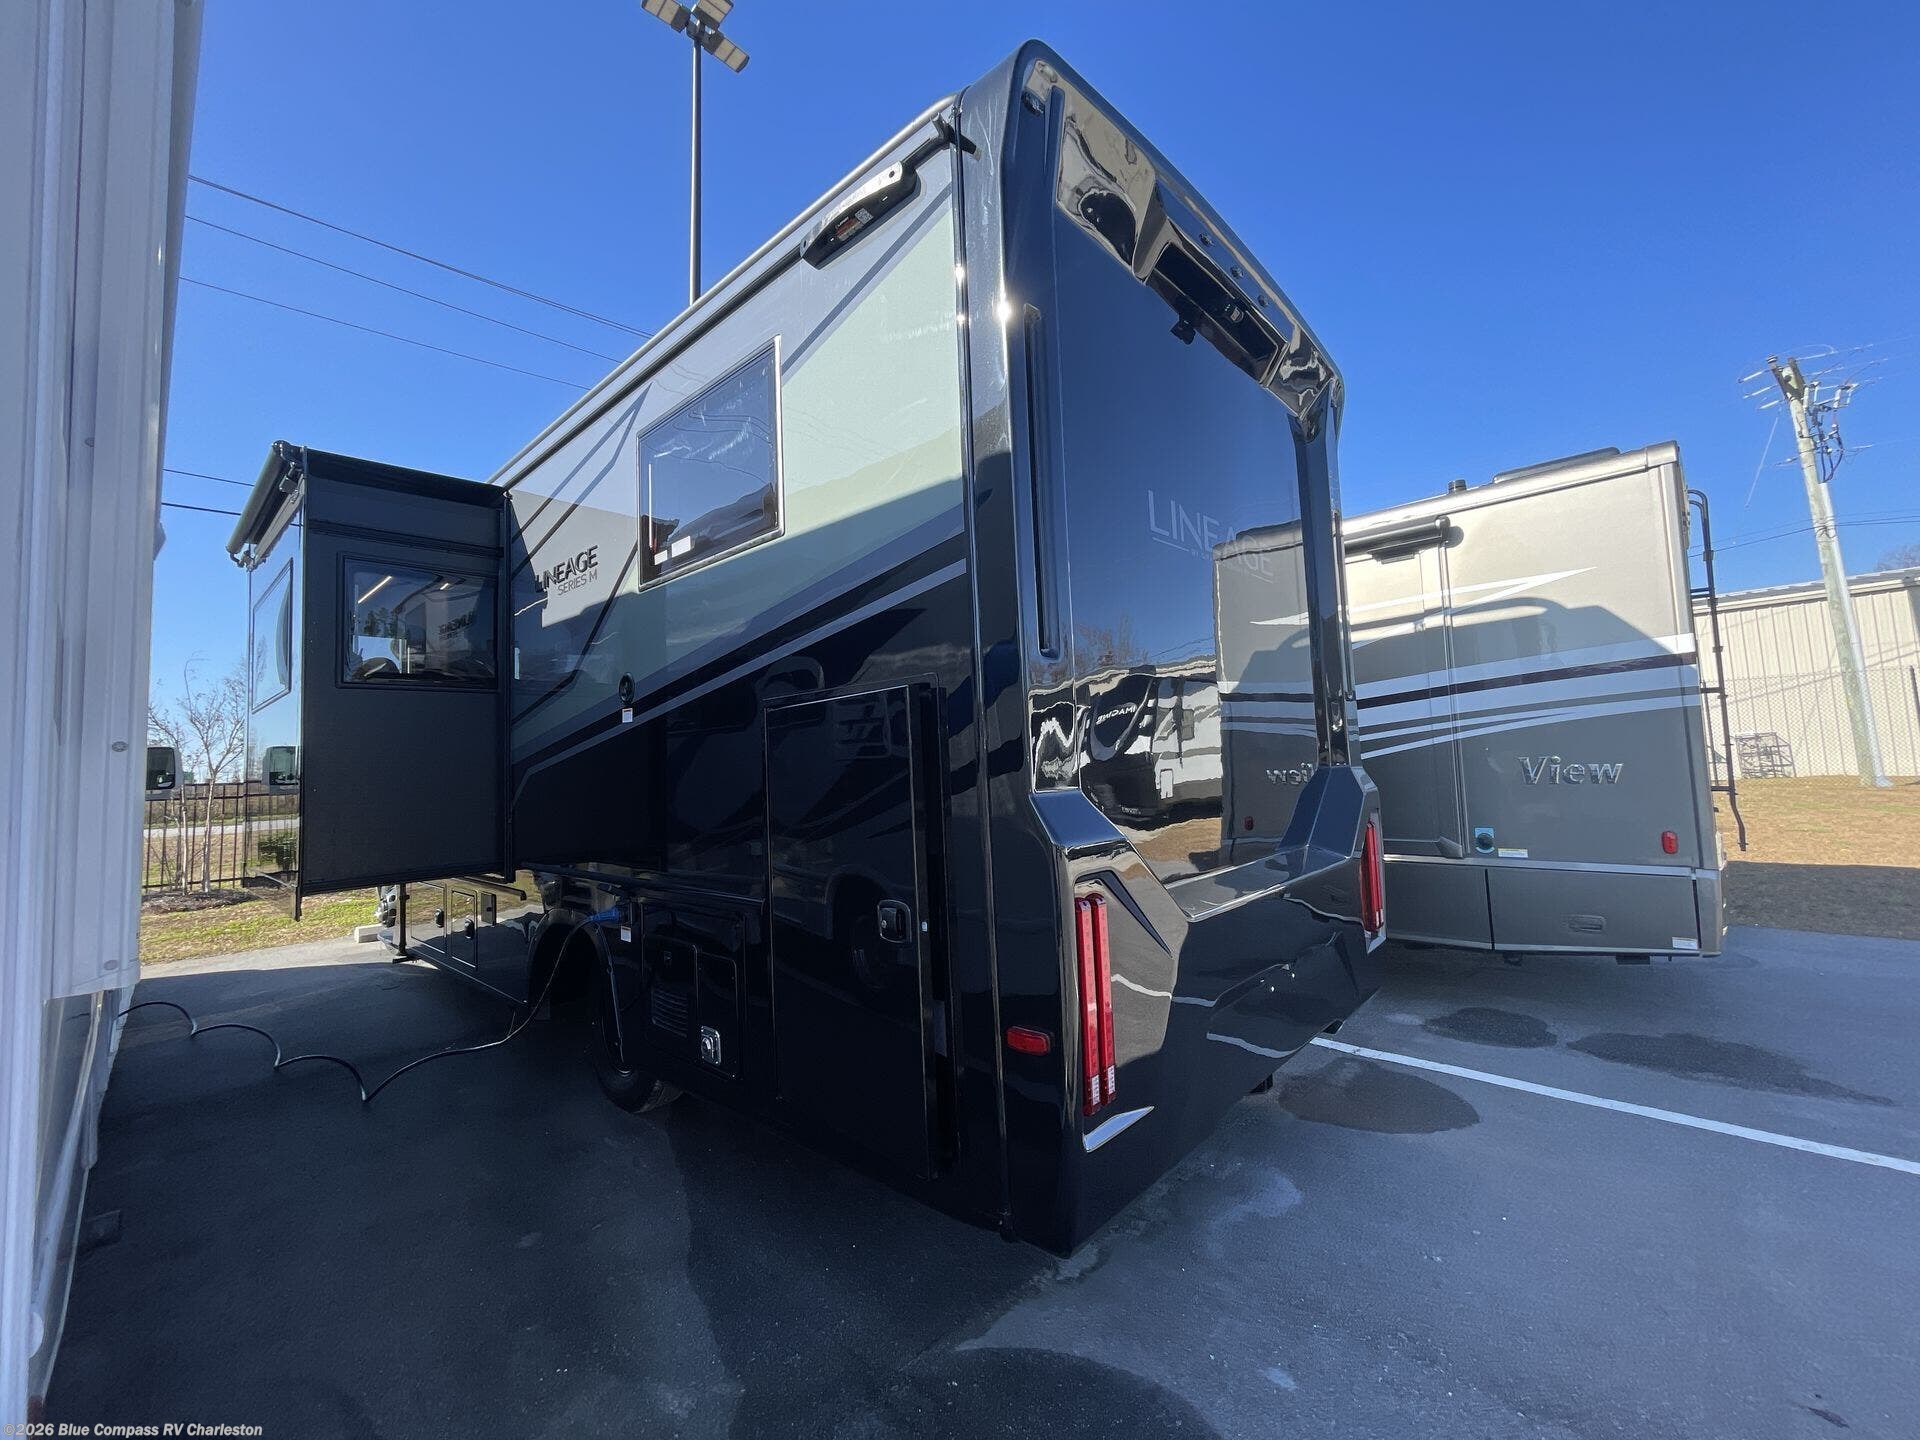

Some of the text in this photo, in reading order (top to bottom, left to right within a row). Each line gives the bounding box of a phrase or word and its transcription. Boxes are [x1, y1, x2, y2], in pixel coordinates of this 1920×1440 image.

[1148, 490, 1274, 577] LINEAGE
[535, 545, 598, 593] LINEAGE
[557, 568, 598, 596] SERIES M
[1518, 755, 1624, 785] View
